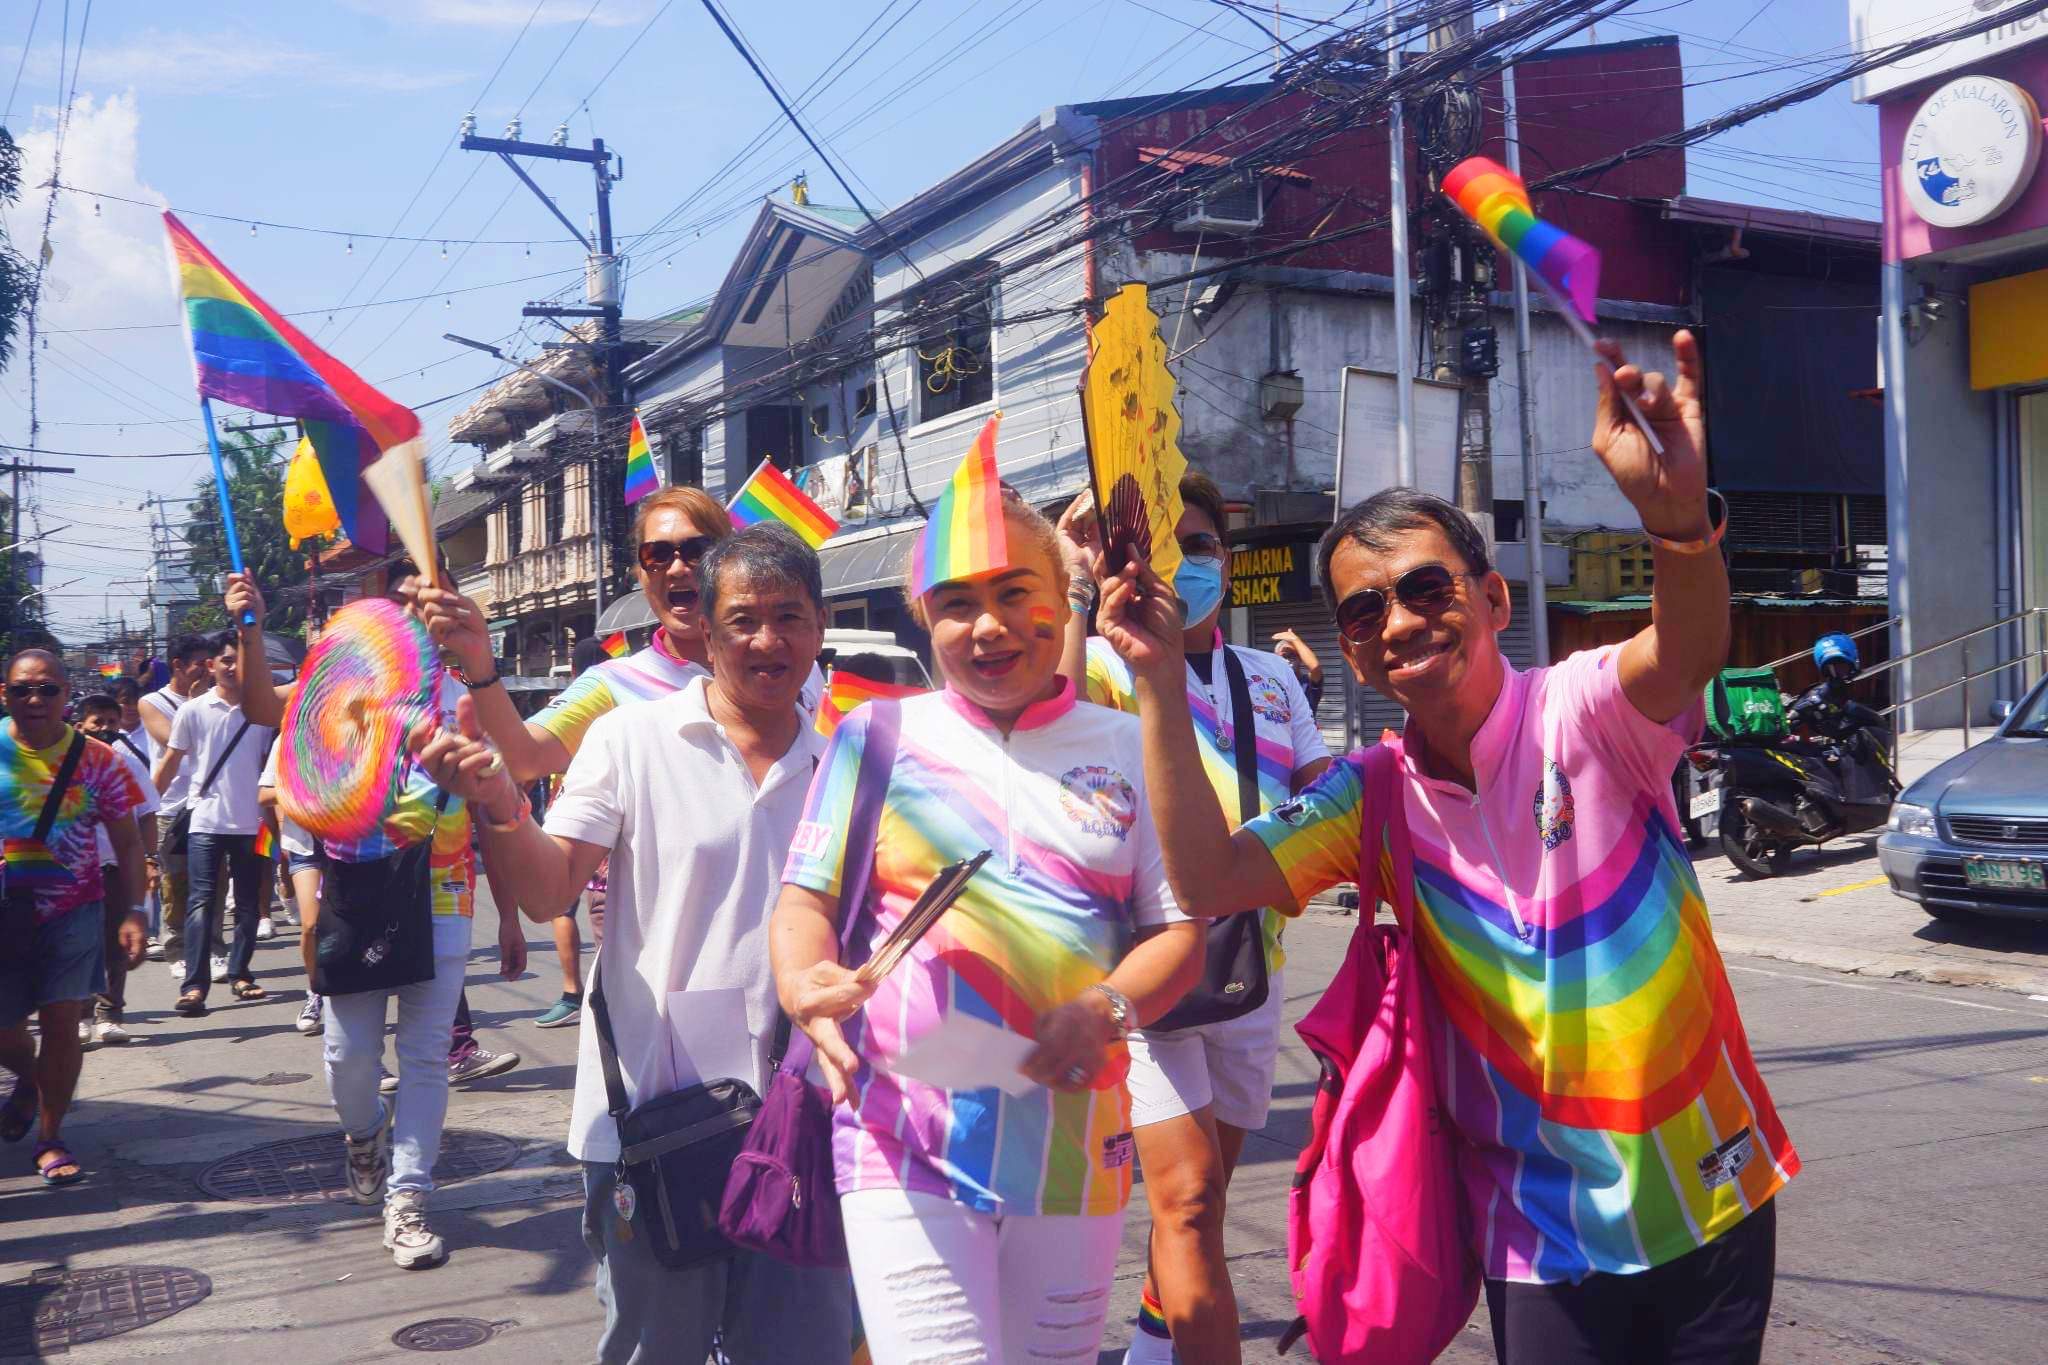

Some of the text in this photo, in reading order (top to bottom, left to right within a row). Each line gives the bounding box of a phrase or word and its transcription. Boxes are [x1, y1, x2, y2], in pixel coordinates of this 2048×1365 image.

[1907, 85, 2020, 161] CITY OF MALABON
[1231, 546, 1294, 577] AWARMA
[1231, 576, 1281, 605] SHACK
[1743, 700, 1775, 715] Grab
